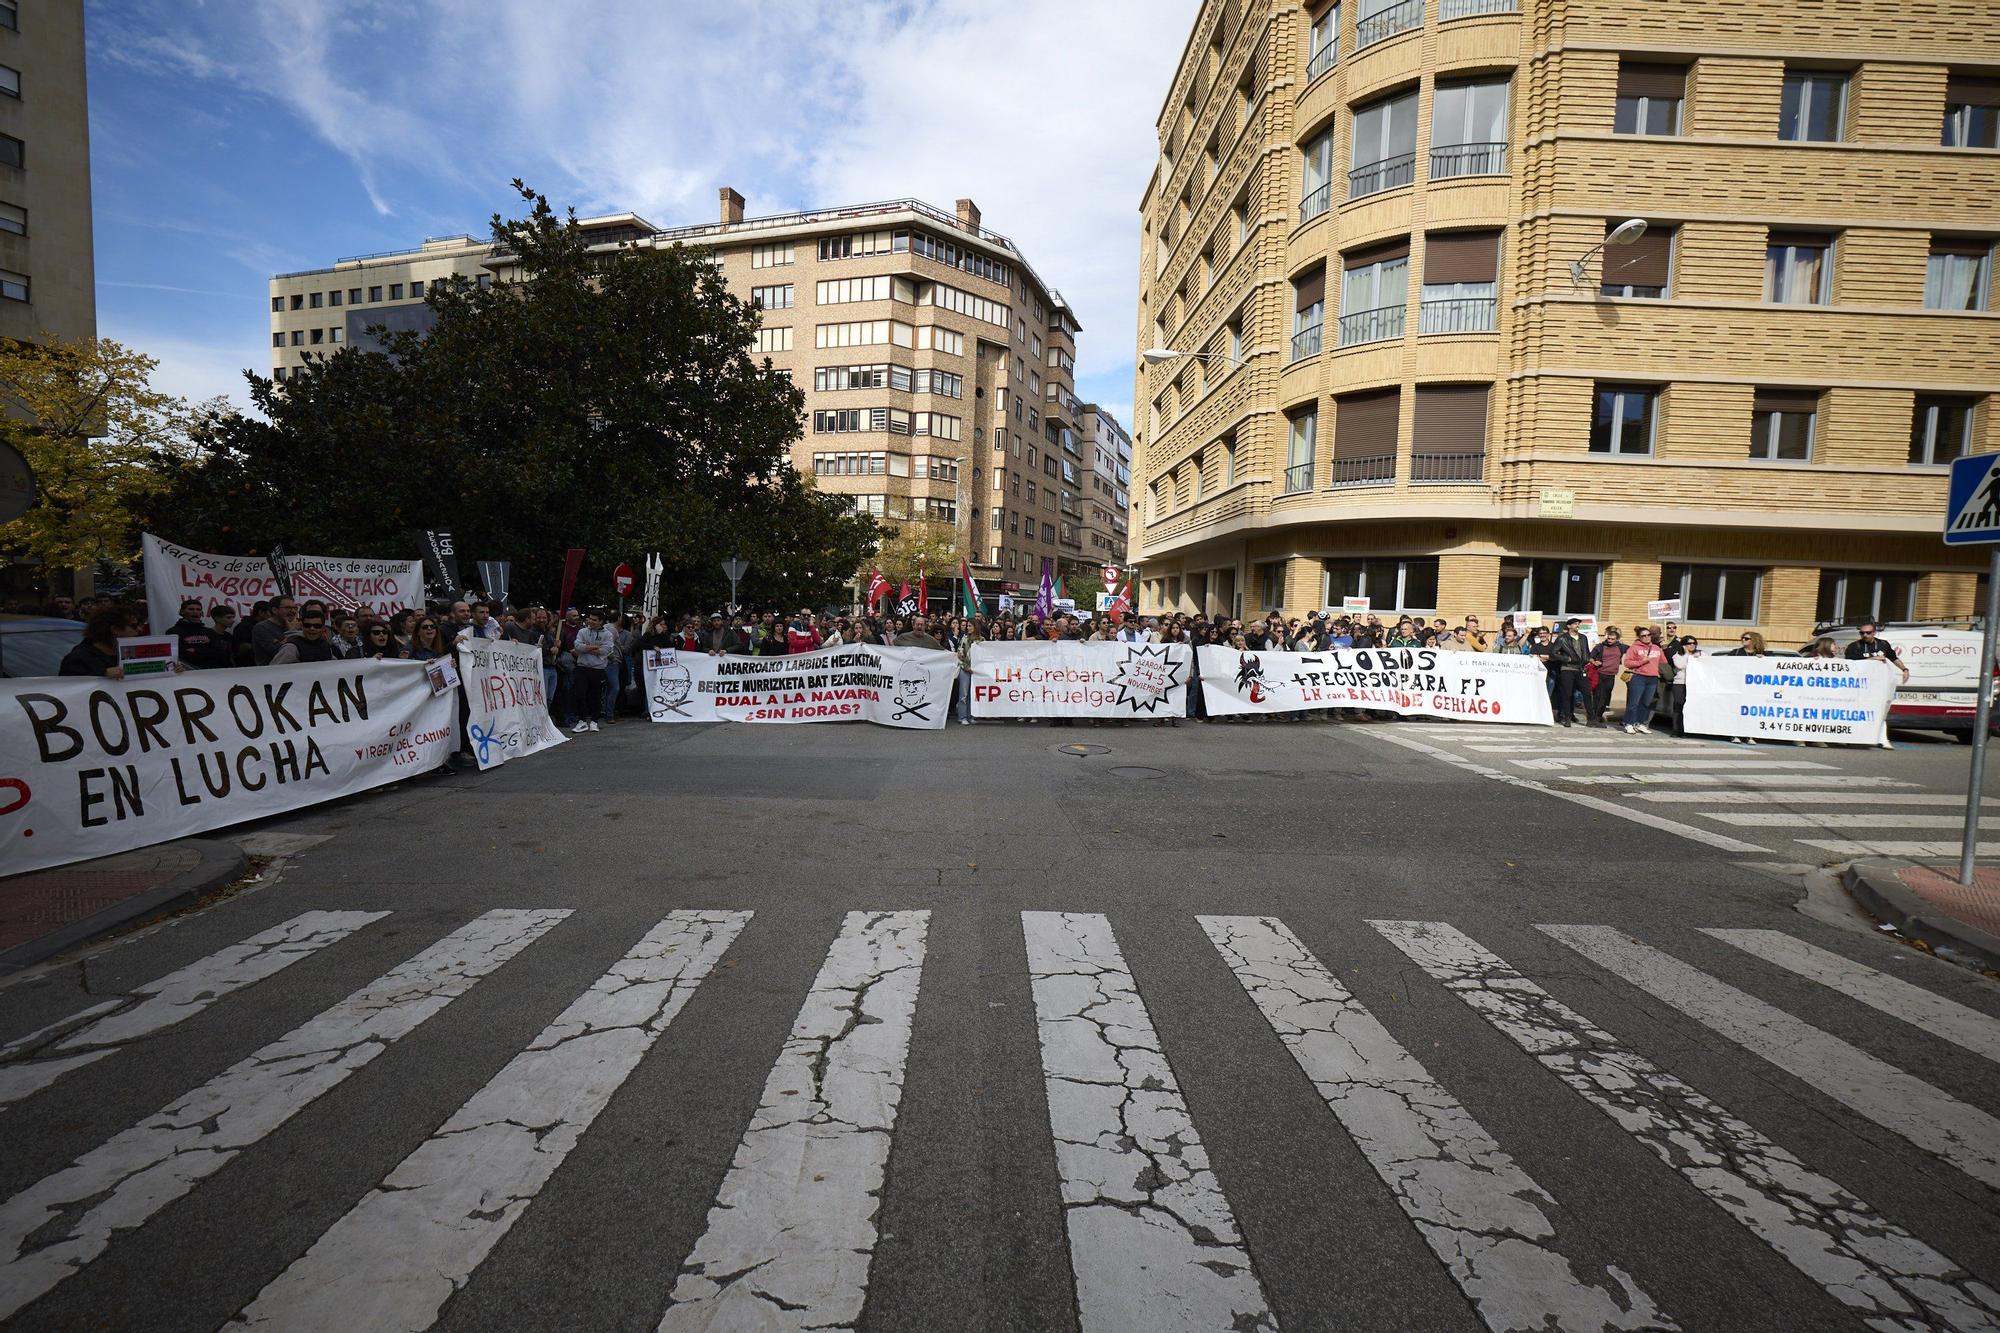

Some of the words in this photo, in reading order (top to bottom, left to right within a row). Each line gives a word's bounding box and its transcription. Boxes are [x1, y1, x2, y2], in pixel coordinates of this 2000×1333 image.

[224, 558, 242, 573] de
[245, 561, 266, 573] ser
[346, 560, 361, 573] de
[363, 560, 412, 577] segunda!
[1331, 649, 1438, 671] LOBOS
[1911, 644, 1977, 657] prodein
[717, 661, 784, 676] NAFARROAKO
[995, 667, 1022, 683] LH
[1029, 665, 1105, 684] Greban
[1136, 659, 1167, 673] AZAROAK
[1823, 662, 1829, 671] 4
[698, 680, 740, 694] BERTZE
[742, 676, 805, 693] MURRIZKETA
[808, 674, 828, 688] BAT
[1133, 666, 1166, 686] 3-4-5
[1401, 673, 1448, 693] PARA
[1461, 678, 1487, 696] FP
[1745, 674, 1804, 688] DONAPEA
[1806, 676, 1868, 689] GREBARA!!
[1127, 677, 1163, 695] NOVIEMBRE
[1301, 687, 1323, 702] LH
[715, 695, 762, 707] DUAL
[766, 694, 778, 705] A
[783, 692, 806, 704] LA
[811, 688, 880, 702] NAVARRA
[975, 685, 1002, 703] FP
[1008, 689, 1035, 703] en
[1042, 685, 1116, 708] huelga
[15, 675, 369, 763] BORROKAN
[745, 708, 785, 721] ¿SIN
[791, 703, 861, 718] HORAS?
[1741, 705, 1800, 719] DONAPEA
[1802, 708, 1818, 720] EN
[1821, 708, 1875, 722] HUELGA!!
[1769, 722, 1776, 730] 4
[1777, 723, 1783, 731] Y
[1785, 723, 1791, 731] 5
[1793, 723, 1804, 732] DE
[1805, 724, 1852, 735] NOVIEMBRE
[355, 742, 395, 761] VIRGEN
[396, 738, 414, 752] DEL
[415, 726, 451, 746] CAMINO
[78, 765, 145, 828] EN
[170, 736, 330, 806] LUCHA
